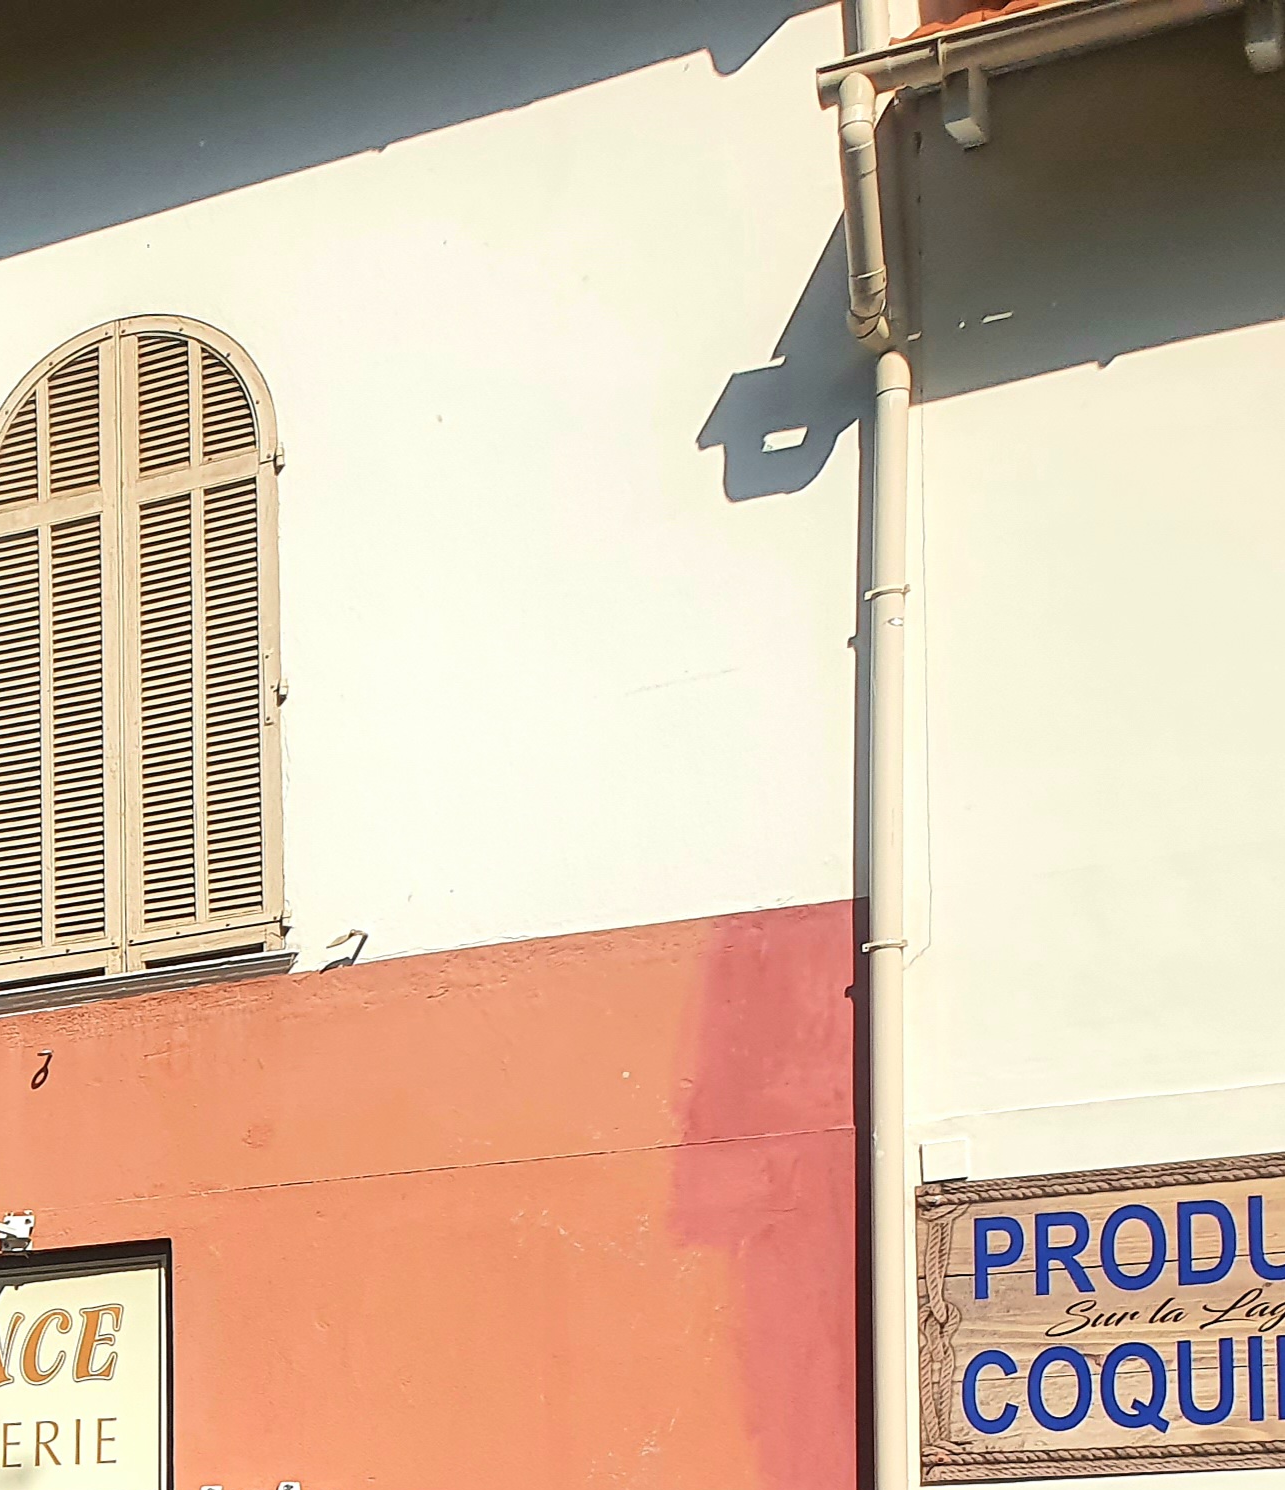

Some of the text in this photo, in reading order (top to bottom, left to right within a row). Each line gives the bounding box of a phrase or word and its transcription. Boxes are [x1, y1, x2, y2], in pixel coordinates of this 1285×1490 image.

[973, 1195, 1285, 1300] PRODU
[1044, 1299, 1139, 1337] Sur
[1148, 1297, 1189, 1324] la
[961, 1334, 1285, 1434] COQUI
